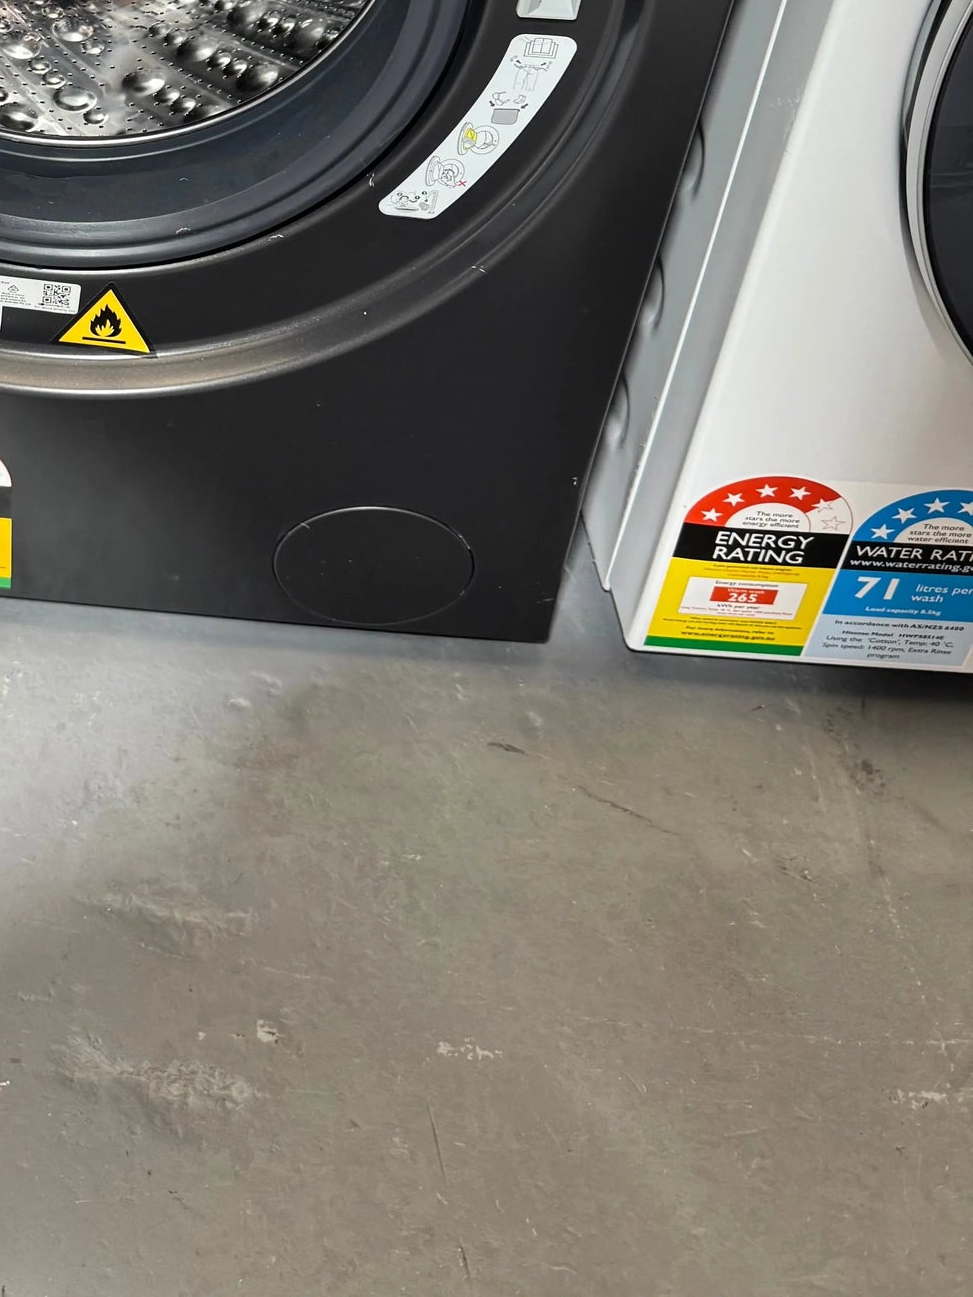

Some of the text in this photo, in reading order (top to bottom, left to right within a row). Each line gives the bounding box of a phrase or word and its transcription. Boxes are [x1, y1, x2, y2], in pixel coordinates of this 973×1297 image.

[714, 530, 815, 550] ENERGY
[712, 546, 805, 565] RATING
[855, 545, 923, 560] WATER
[915, 583, 948, 593] litres
[951, 587, 973, 596] per
[727, 593, 759, 603] 265
[911, 594, 944, 603] wash
[866, 652, 900, 660] program
